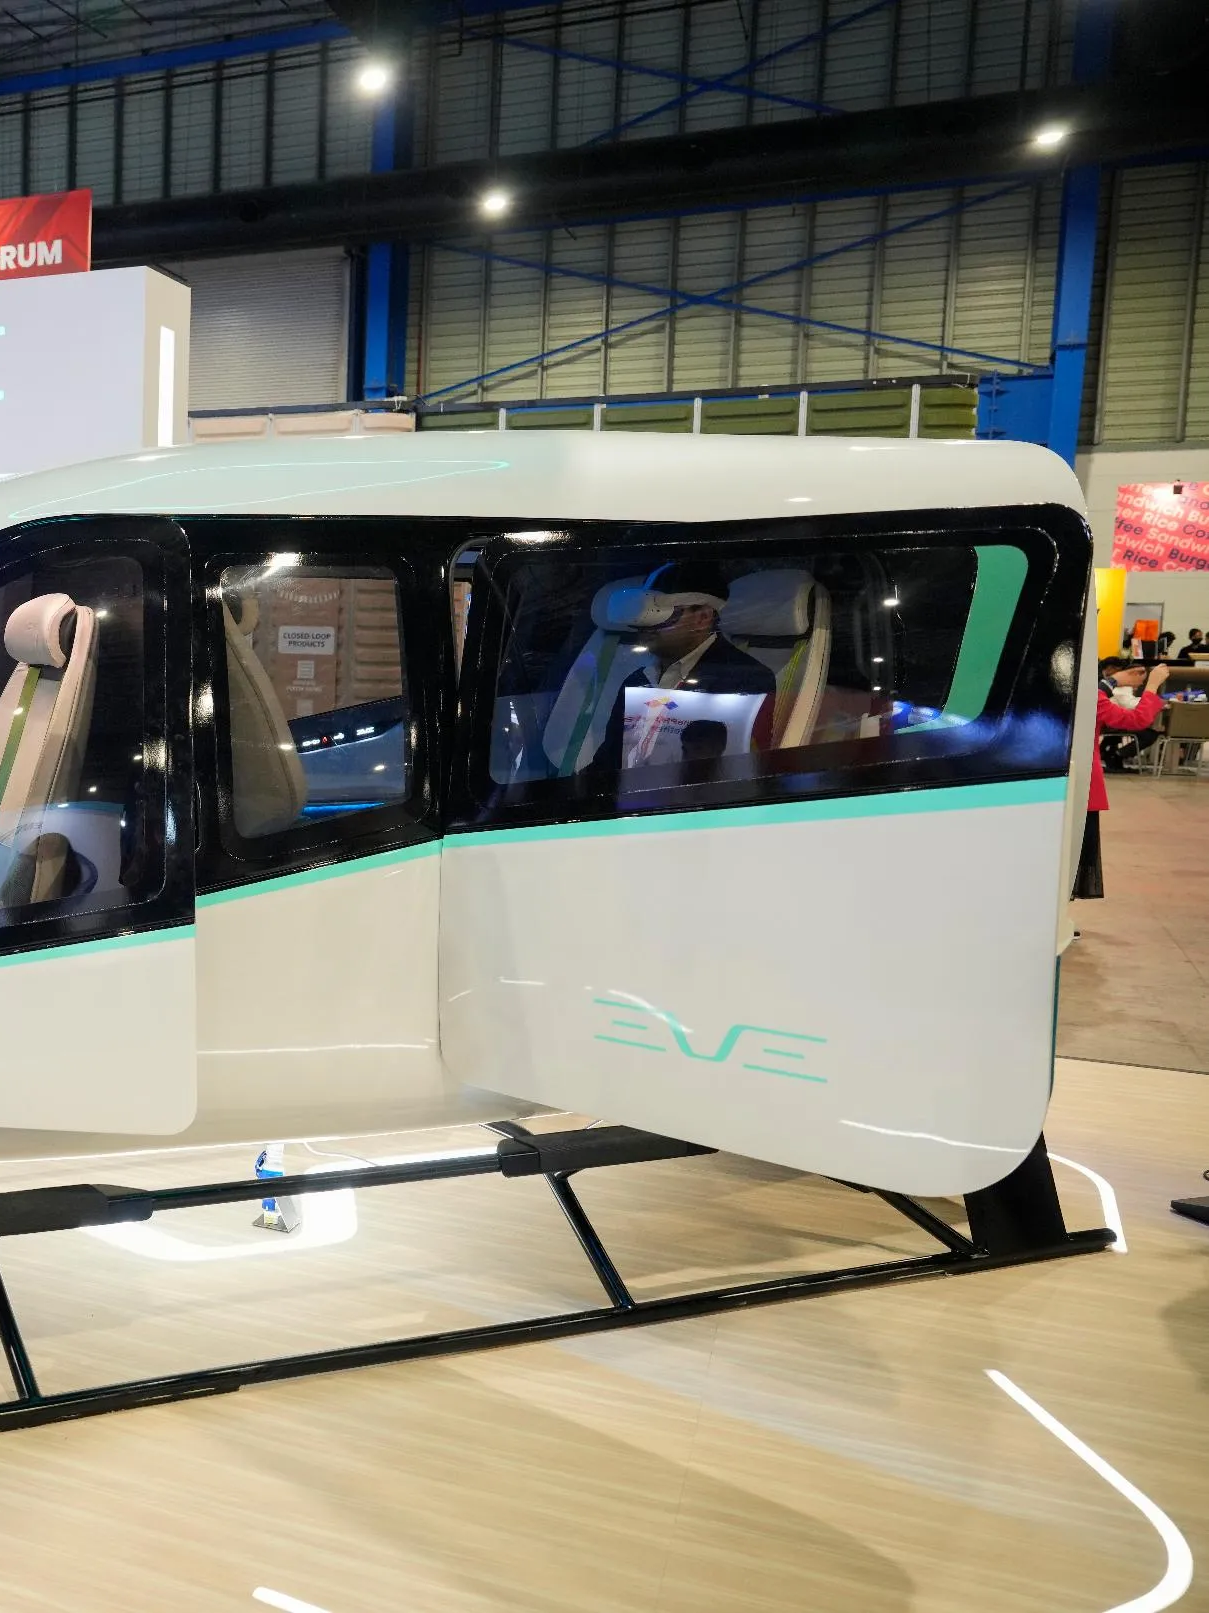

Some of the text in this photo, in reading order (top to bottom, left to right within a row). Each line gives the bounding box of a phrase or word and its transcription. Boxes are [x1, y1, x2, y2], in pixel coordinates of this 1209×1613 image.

[1141, 511, 1179, 531] Rice
[1123, 549, 1159, 568] Rice
[288, 640, 326, 648] PRODUCTS
[593, 998, 828, 1083] EVE
